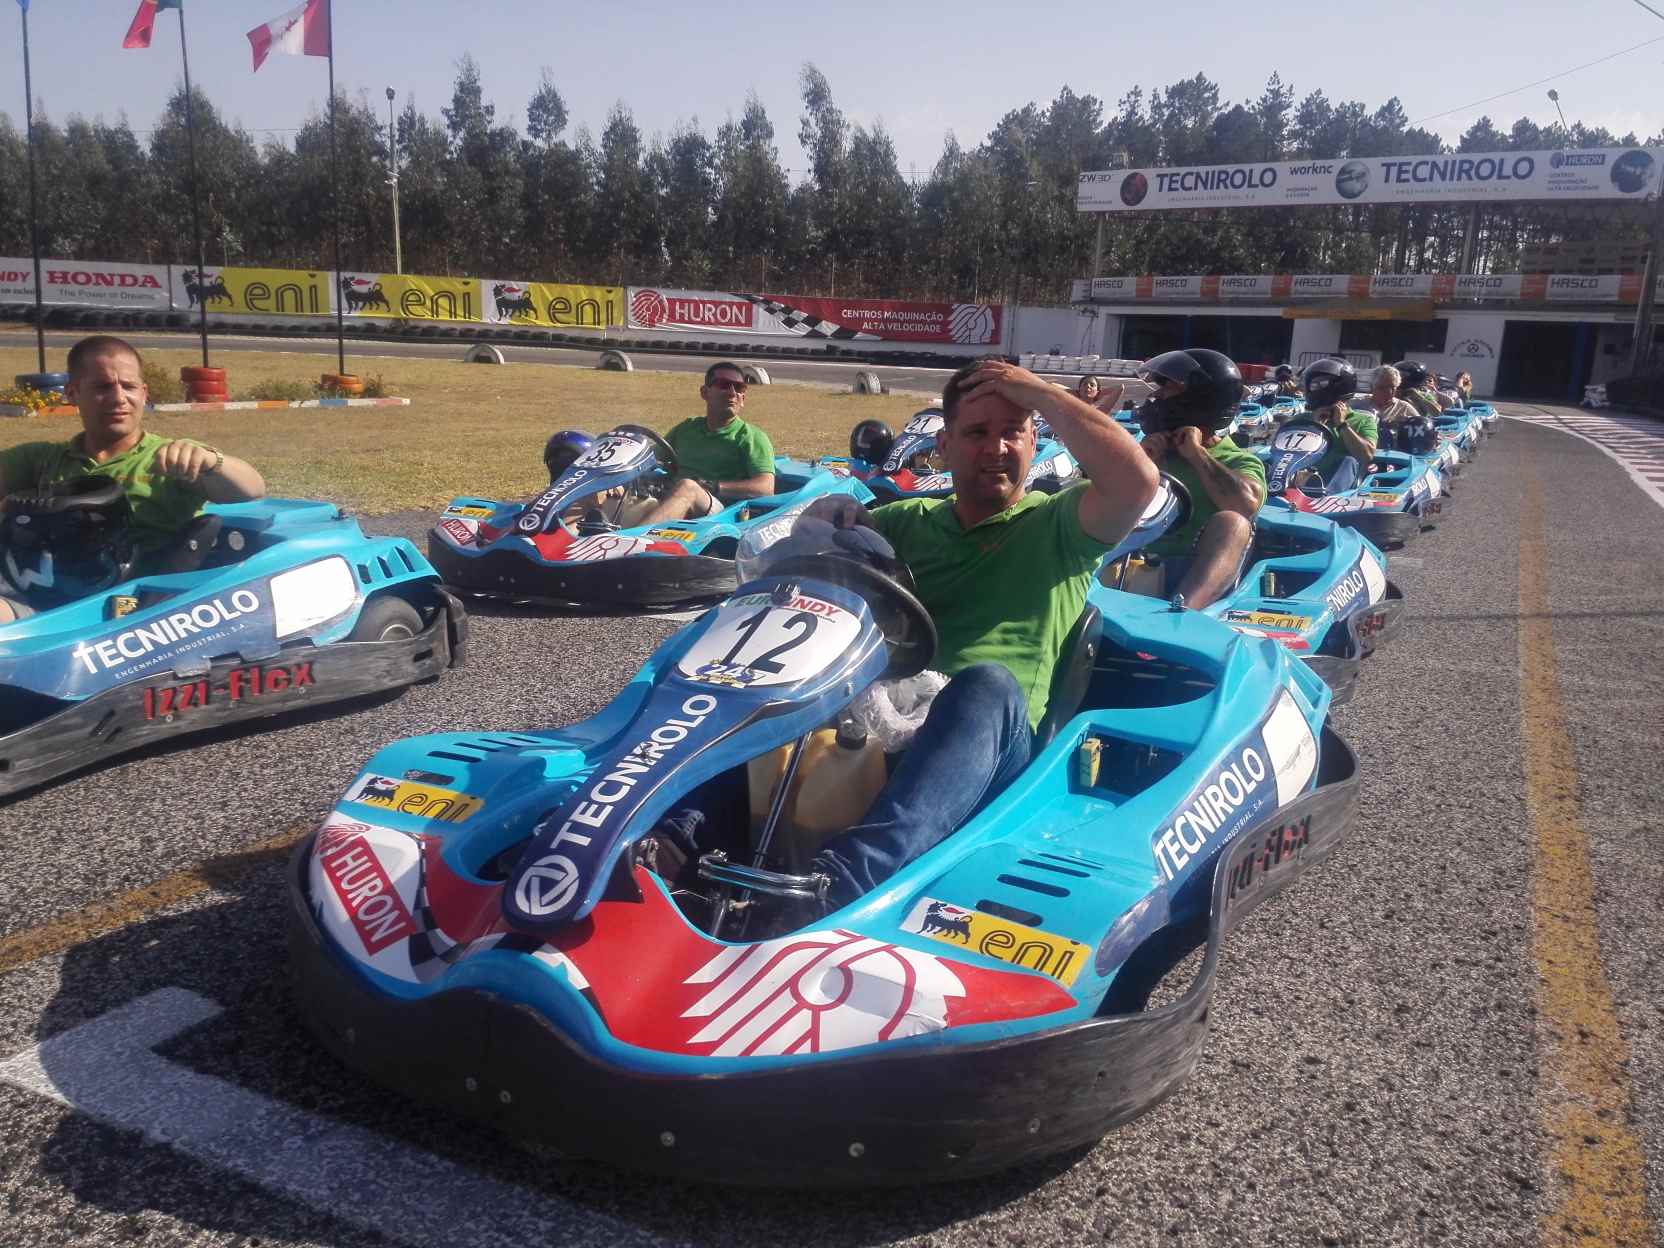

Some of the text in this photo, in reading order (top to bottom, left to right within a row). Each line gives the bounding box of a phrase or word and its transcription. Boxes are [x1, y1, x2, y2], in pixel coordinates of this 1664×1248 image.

[1156, 167, 1277, 193] TECNIROLO
[1289, 162, 1334, 177] worknc
[1381, 156, 1535, 184] TECNIROLO
[47, 270, 162, 288] HONDA
[1095, 279, 1123, 289] HASCO
[1155, 279, 1187, 289] HASCO
[1222, 278, 1257, 288] HASCO
[1294, 278, 1332, 288] HASCO
[1374, 278, 1414, 288] HASCO
[1458, 278, 1503, 288] HASCO
[1550, 278, 1599, 289] HASCO
[243, 273, 320, 313] eni
[400, 280, 471, 319] eni
[549, 289, 614, 326] eni
[675, 301, 746, 324] HURON
[841, 309, 944, 321] CENTROS MAQUINAÇÃO
[862, 321, 942, 333] ALTA VELOCIDADE
[905, 416, 929, 434] 21
[585, 440, 622, 462] 35
[1285, 433, 1307, 449] 17
[72, 589, 260, 675] TECNIROLO
[1257, 616, 1306, 631] eni
[736, 606, 819, 674] 12
[114, 651, 174, 680] ENGENHARIA
[550, 694, 718, 849] TECNIROLO
[396, 792, 478, 821] eni
[1152, 747, 1265, 881] TECNIROLO
[330, 847, 407, 944] HURON
[978, 929, 1081, 980] eni
